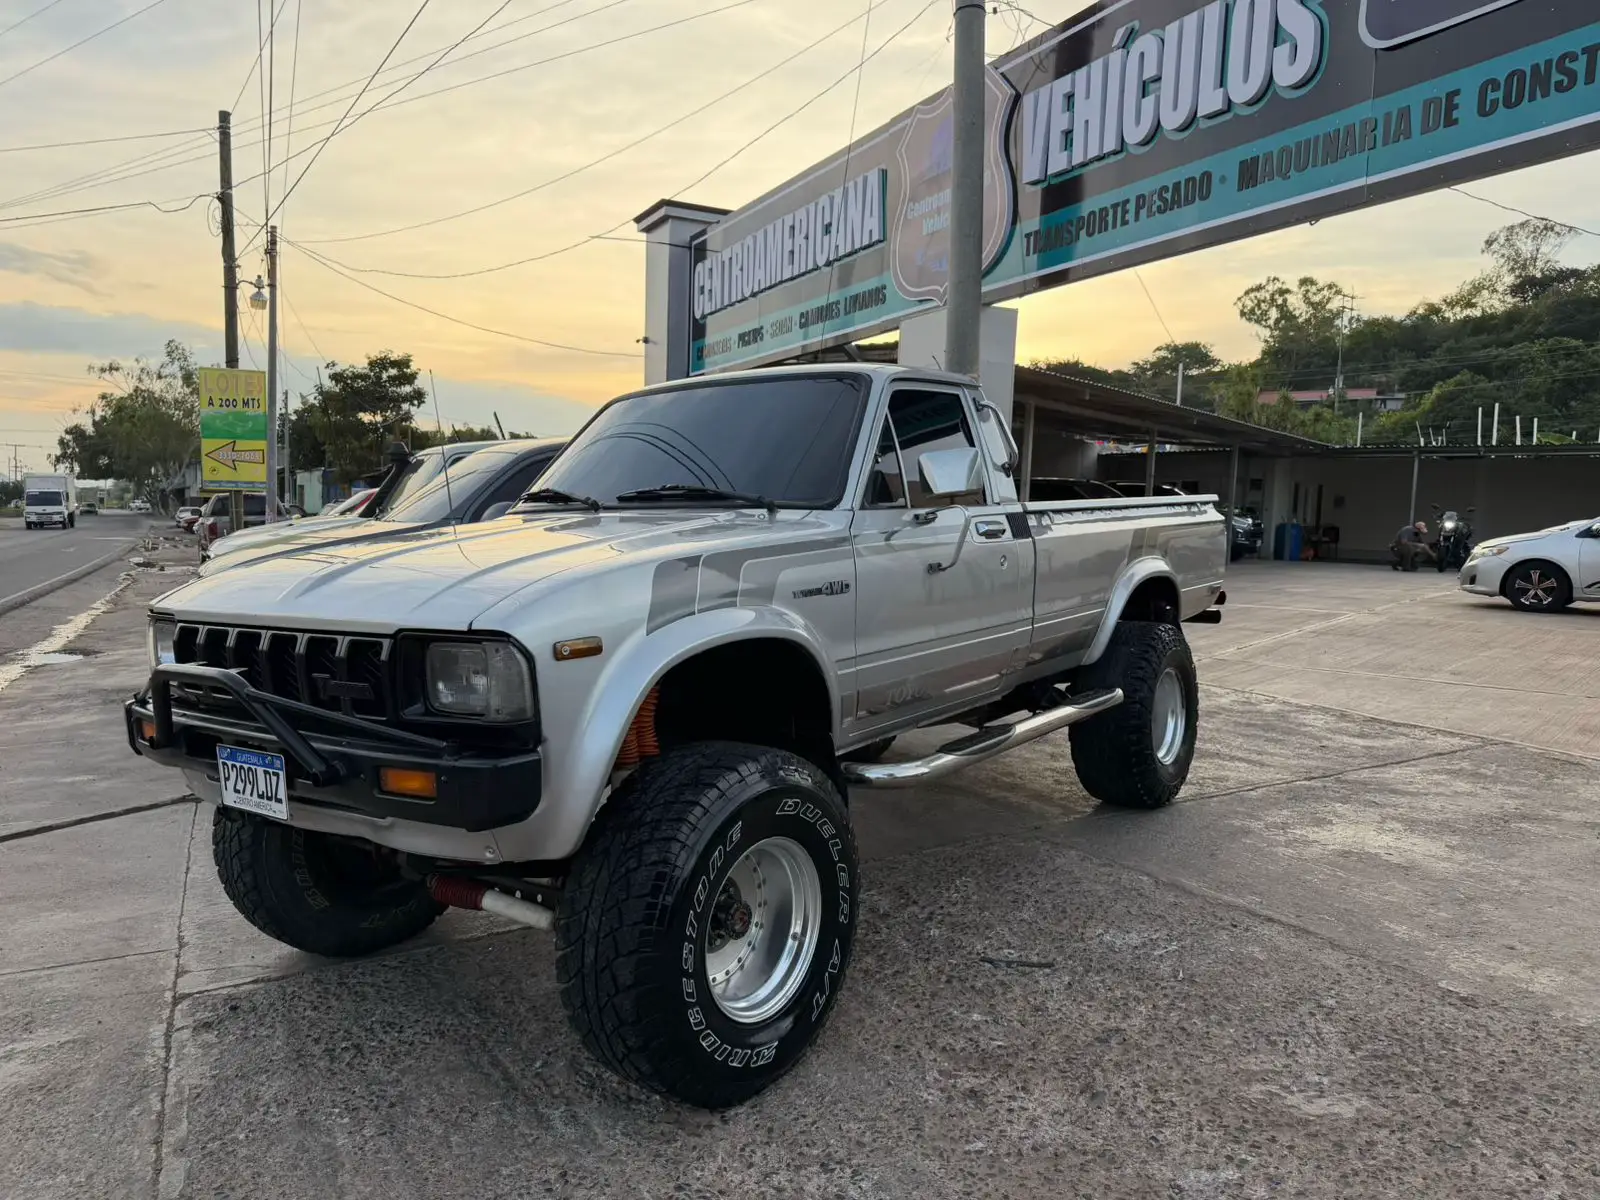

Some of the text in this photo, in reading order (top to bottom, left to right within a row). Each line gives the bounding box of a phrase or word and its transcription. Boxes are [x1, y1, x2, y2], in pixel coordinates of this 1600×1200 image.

[1021, 0, 1322, 184] VEHÍCULOS
[1024, 42, 1600, 257] TRANSPORTE PESADO MAQUINARIA DE CONST
[692, 167, 887, 320] CENTROAMERICANA
[799, 300, 841, 330] CAMIONES
[844, 283, 887, 316] LIVIANOS
[203, 371, 265, 396] LOTES
[207, 395, 261, 409] A 200 MTS
[820, 580, 851, 597] 4WD
[236, 752, 264, 766] GUATEMALA
[221, 761, 283, 804] P299LDZ
[236, 796, 253, 808] CENTRO
[775, 799, 850, 1022] DUELER A/T
[682, 820, 778, 1068] BRIDGESTONE
